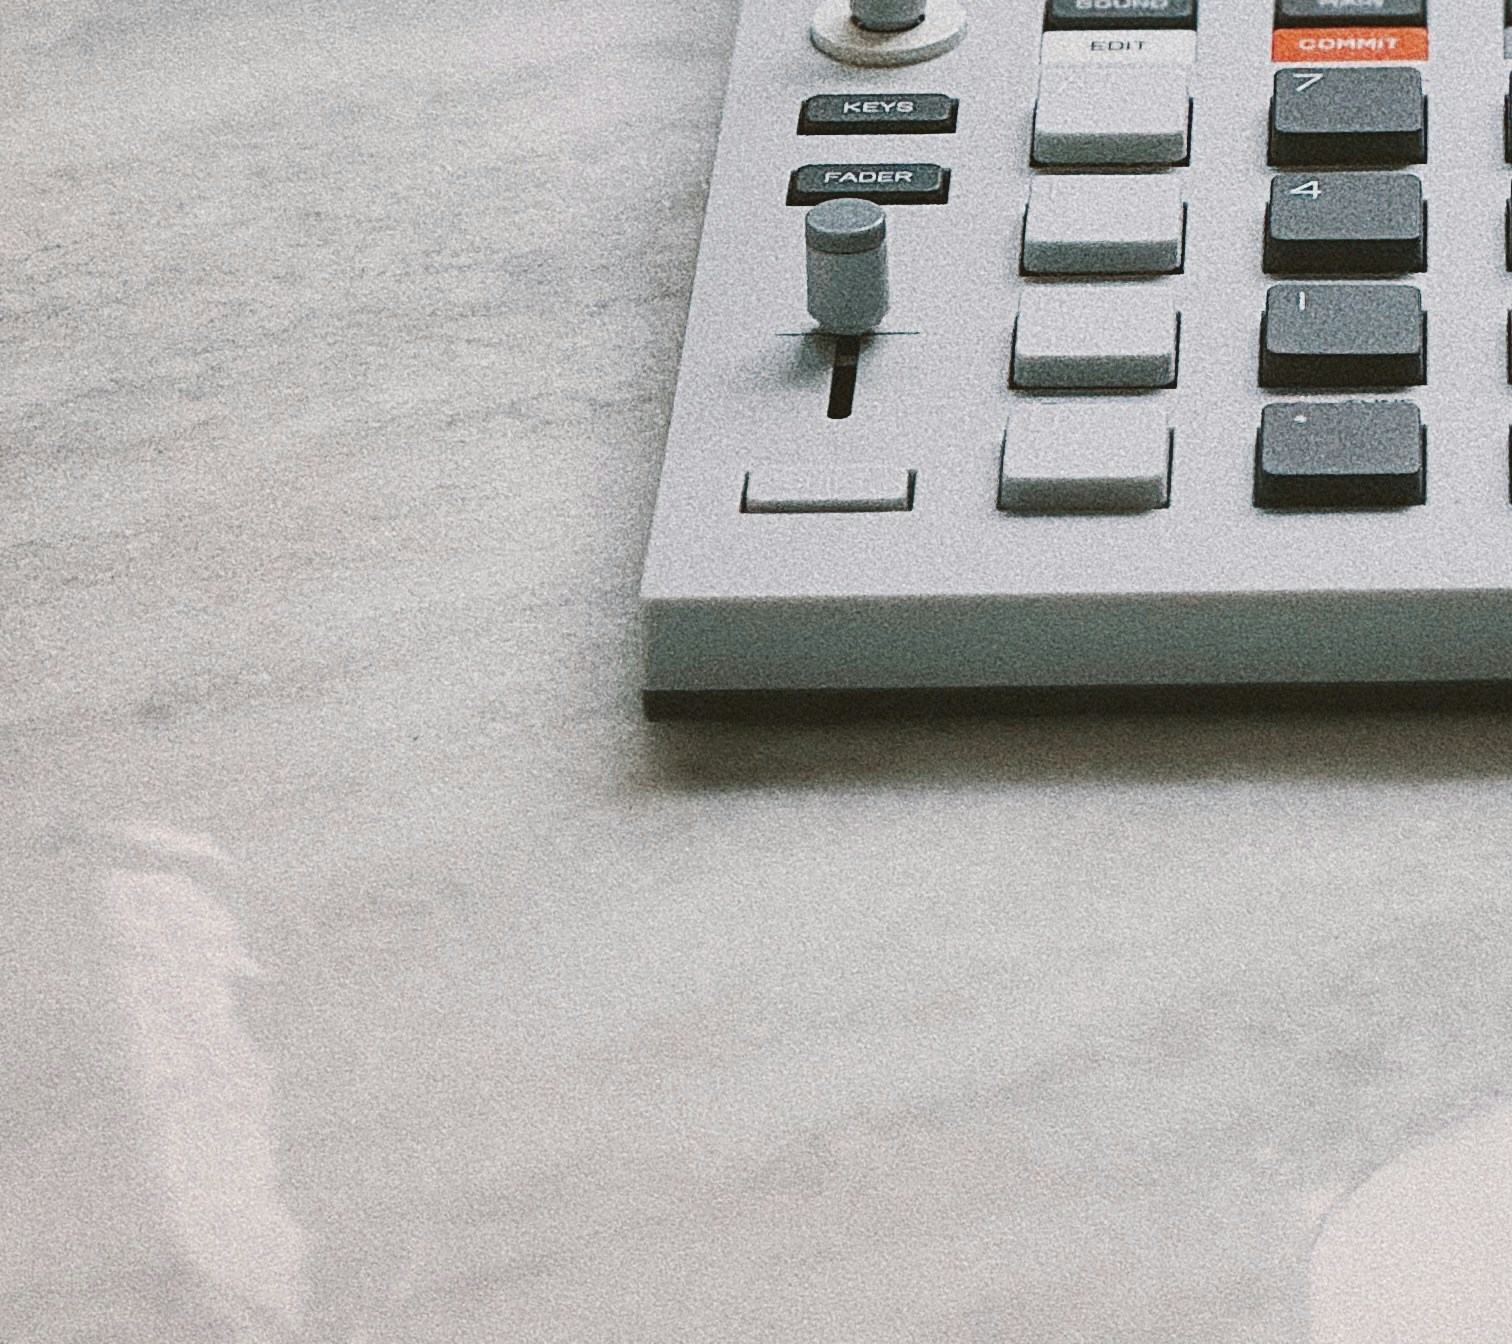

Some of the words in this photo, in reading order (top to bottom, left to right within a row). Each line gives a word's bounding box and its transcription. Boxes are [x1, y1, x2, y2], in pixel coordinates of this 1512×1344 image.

[1091, 40, 1148, 52] EDIT
[1299, 37, 1399, 52] COMMIT
[1292, 73, 1323, 92] 7
[843, 101, 914, 113] KEYS
[824, 171, 913, 183] FADER
[1290, 180, 1322, 200] 4
